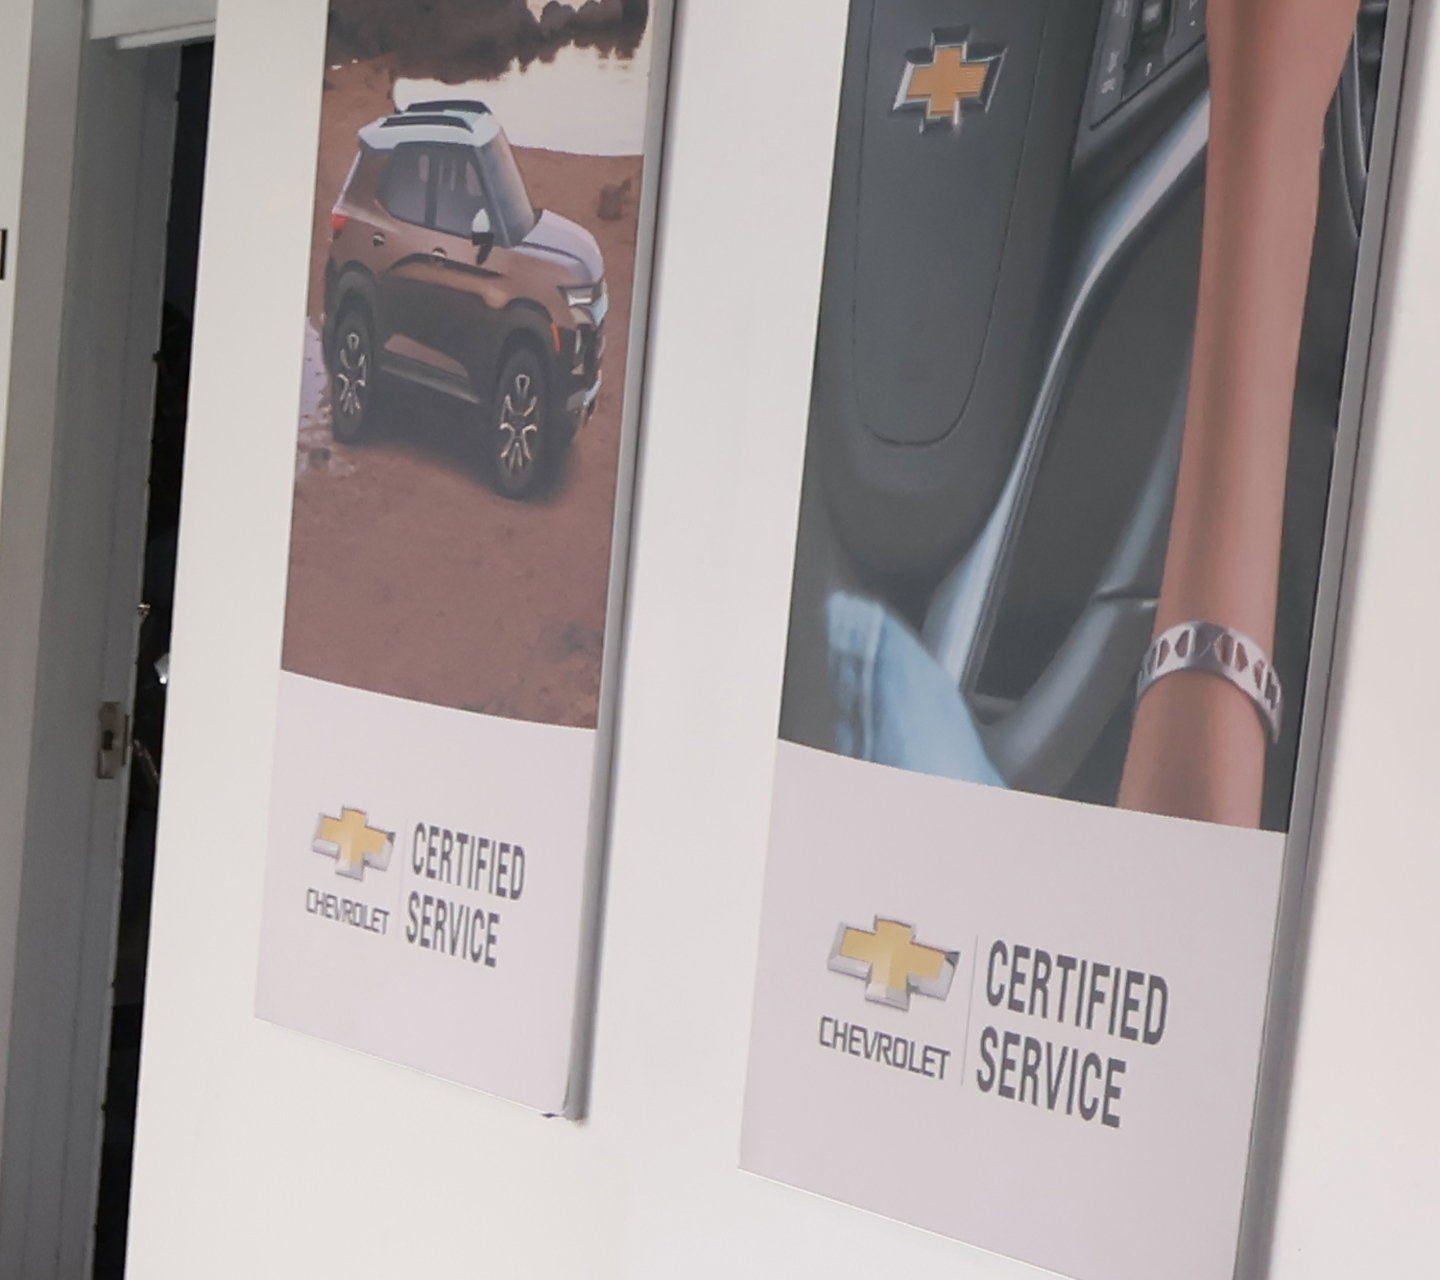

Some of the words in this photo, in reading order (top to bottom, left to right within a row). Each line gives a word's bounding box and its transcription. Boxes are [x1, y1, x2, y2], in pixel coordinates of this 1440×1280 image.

[412, 821, 526, 901] CERTIFIED
[305, 887, 390, 936] CHEVROLET
[405, 890, 501, 968] SERVICE
[986, 939, 1169, 1046] CERTIFIED
[818, 1016, 951, 1080] CHEVROLET
[976, 1025, 1127, 1129] SERVICE
